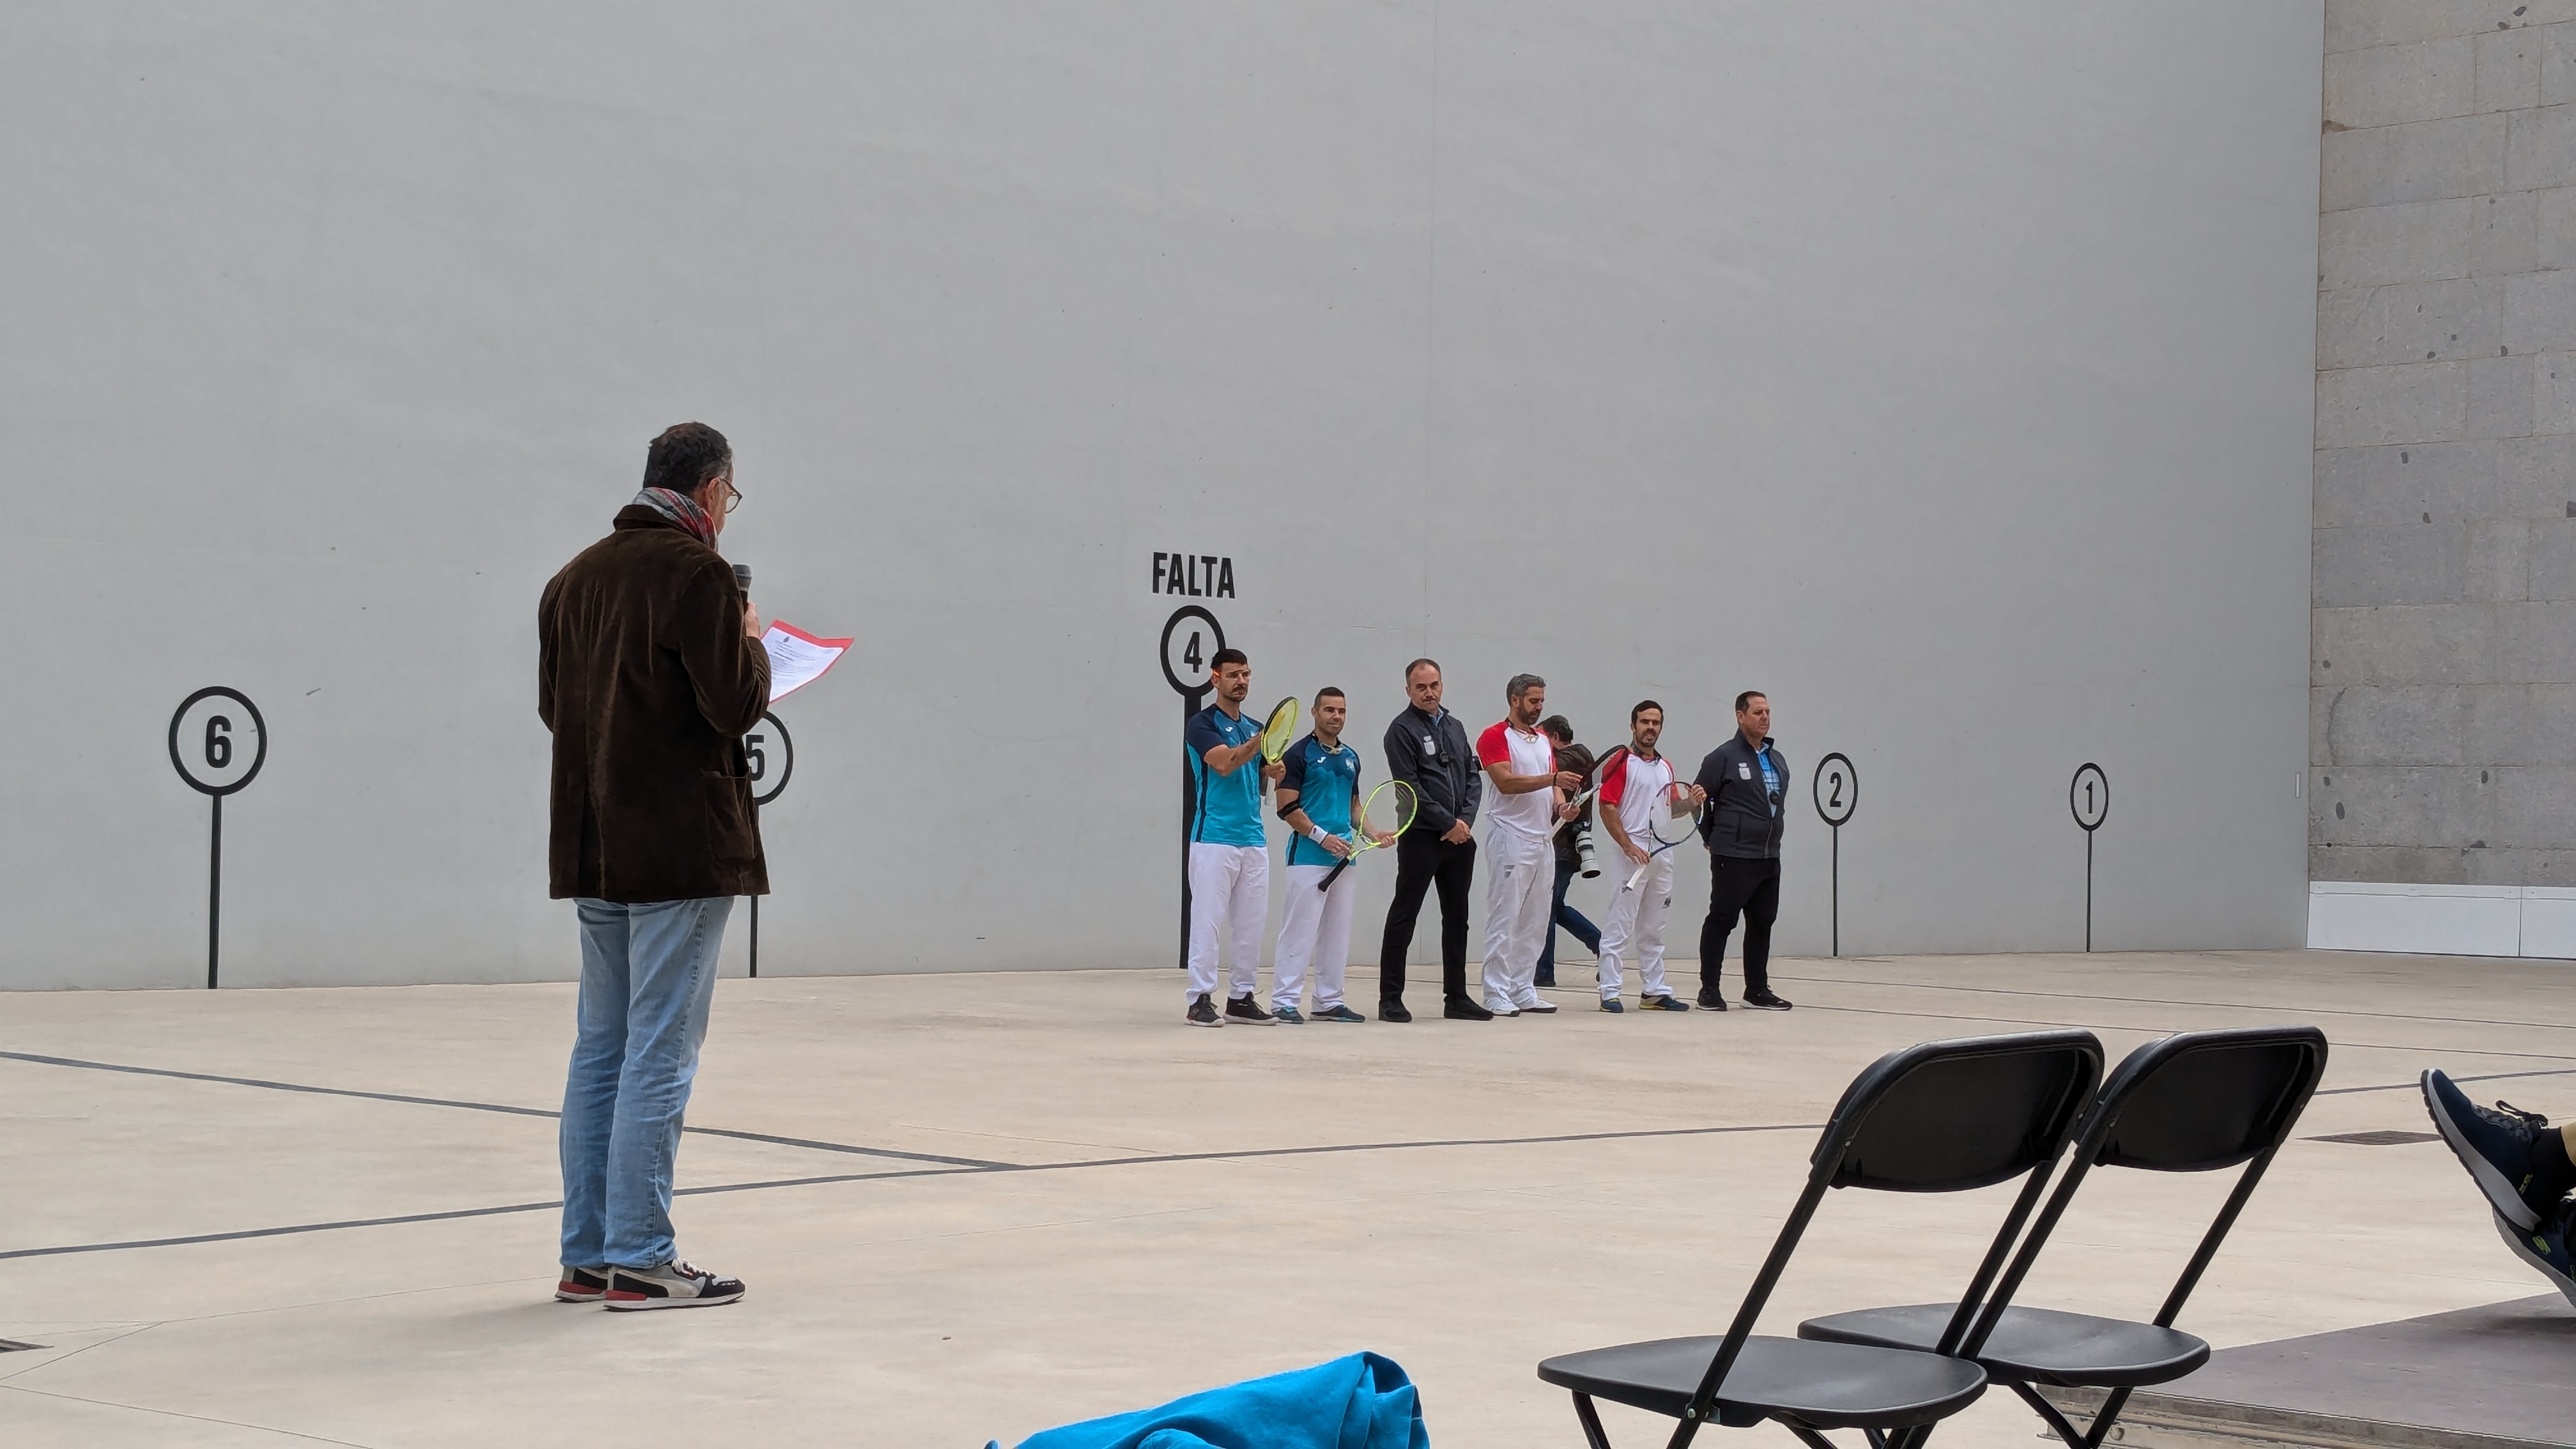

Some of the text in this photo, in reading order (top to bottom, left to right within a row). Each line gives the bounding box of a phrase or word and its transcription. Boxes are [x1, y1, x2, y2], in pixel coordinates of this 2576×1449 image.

[1152, 551, 1236, 599] FALTA
[1183, 632, 1203, 674] 4
[205, 715, 232, 769] 6
[746, 734, 765, 781] 5
[1829, 772, 1842, 808] 2
[2085, 781, 2093, 812] 1
